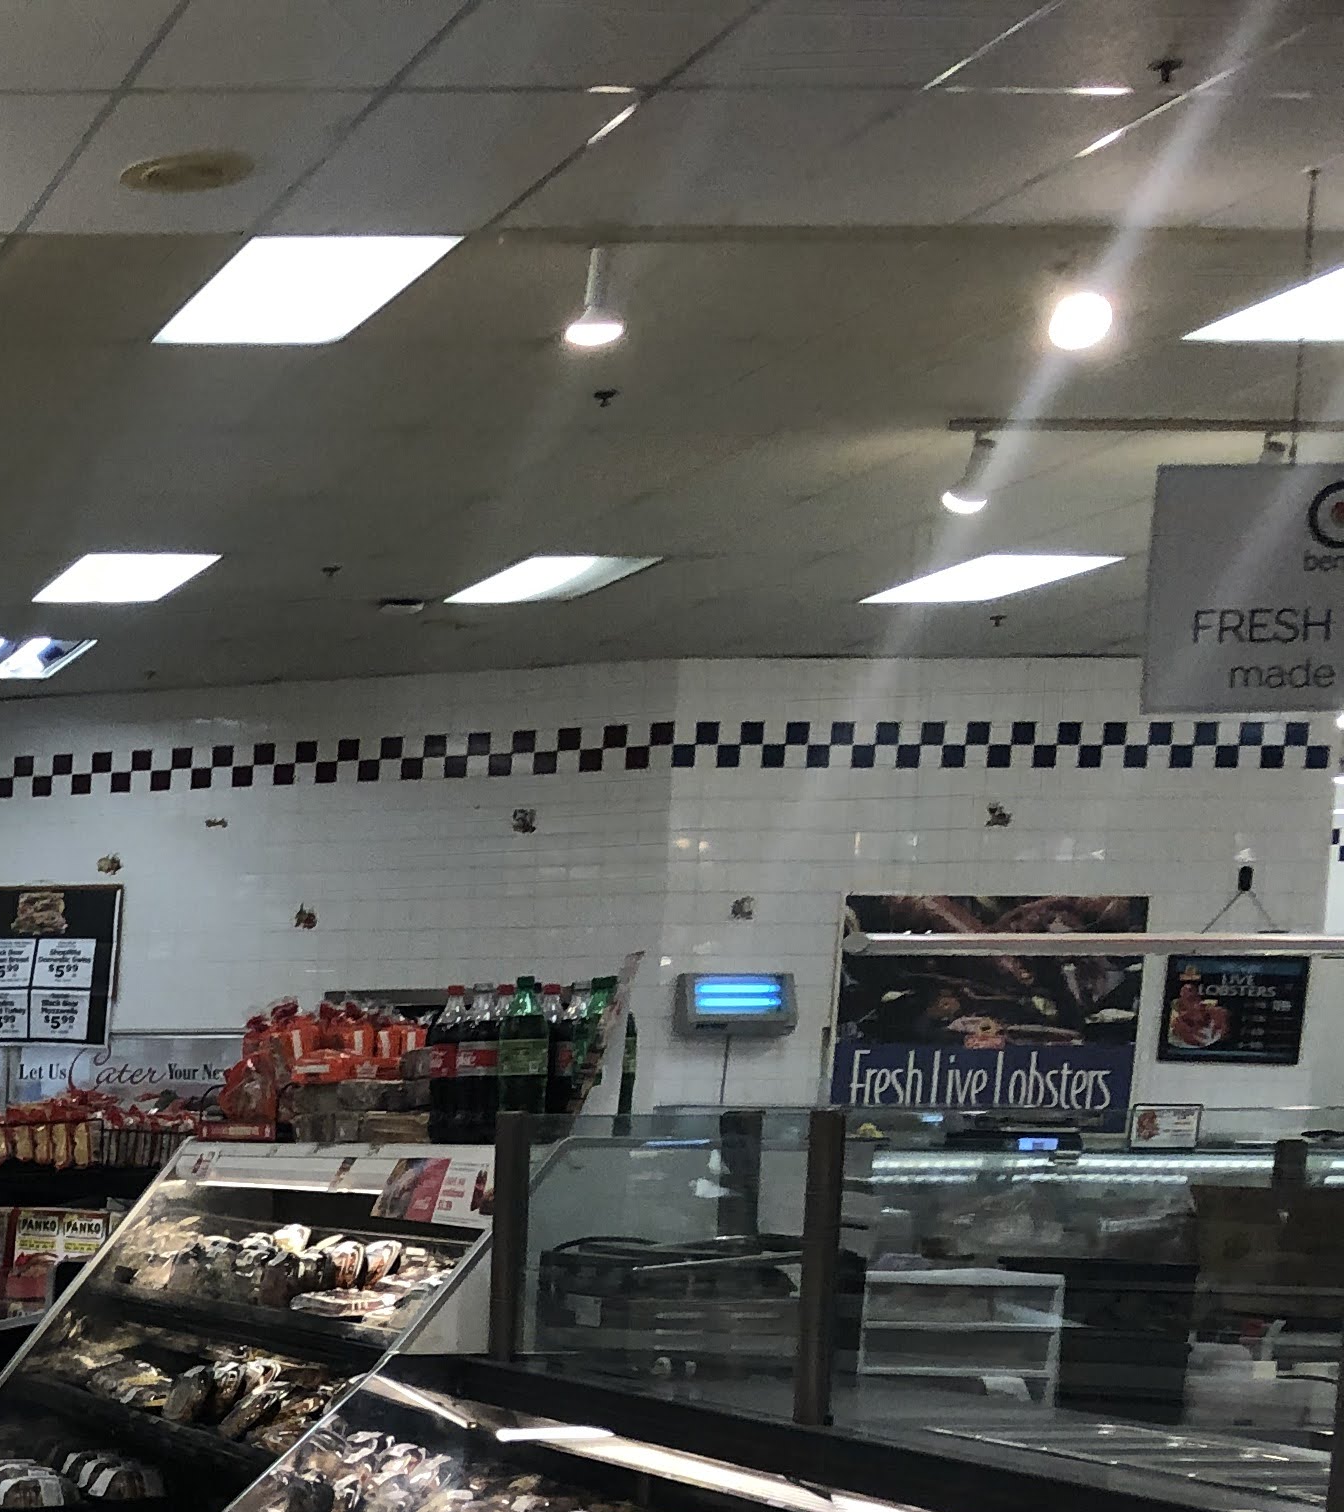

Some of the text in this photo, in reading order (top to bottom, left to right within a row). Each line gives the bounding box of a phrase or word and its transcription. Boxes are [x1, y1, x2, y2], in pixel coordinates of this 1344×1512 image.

[1192, 608, 1332, 643] FRESH
[1229, 658, 1336, 689] made
[1197, 984, 1277, 998] LOBSTERS
[1221, 974, 1256, 986] LIVE
[19, 1063, 44, 1080] Let
[49, 1063, 66, 1080] Us
[68, 1048, 165, 1091] Cater
[168, 1063, 200, 1080] Your
[849, 1049, 1112, 1110] Fresh Live Lobsters
[21, 1217, 57, 1232] PANKO
[66, 1220, 101, 1235] PANKO
